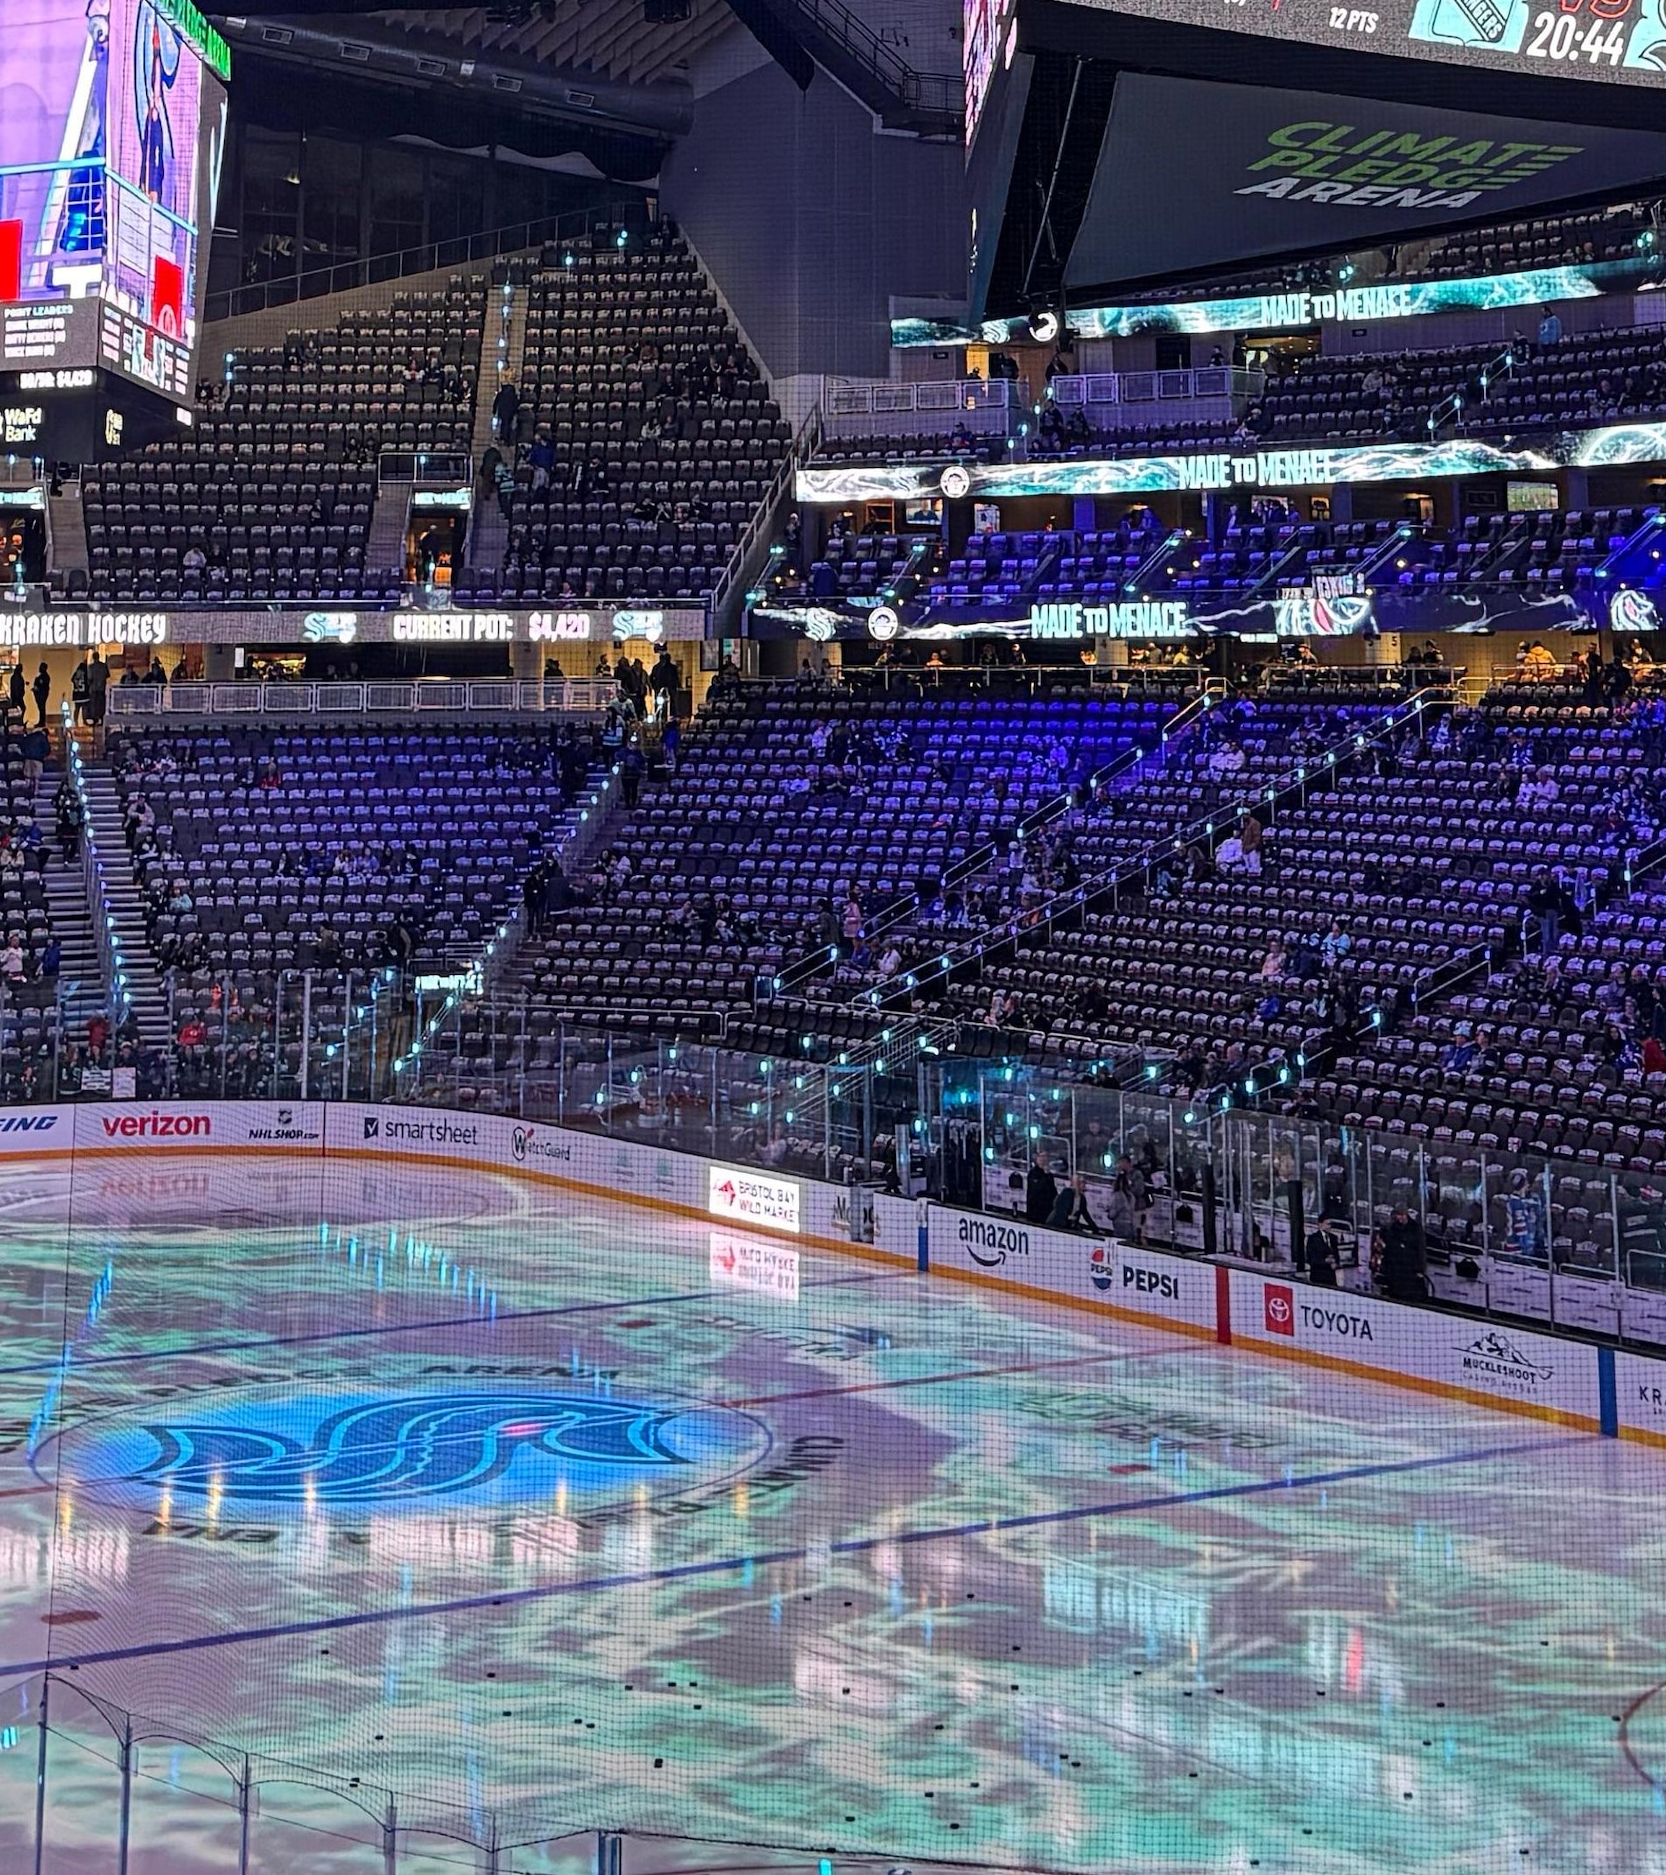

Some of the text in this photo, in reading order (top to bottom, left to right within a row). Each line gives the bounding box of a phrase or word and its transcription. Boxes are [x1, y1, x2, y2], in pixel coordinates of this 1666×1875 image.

[1329, 7, 1379, 33] 12 PTS
[1526, 12, 1626, 67] 20:44
[1267, 121, 1586, 169] CLIMATE
[1246, 149, 1541, 191] PLEDGE
[1233, 177, 1483, 209] ARENA
[1260, 284, 1414, 326] MADE TO MENACE
[4, 407, 42, 426] WaFd
[5, 425, 37, 443] Bank
[1179, 449, 1335, 490] MADE TO MENACE
[87, 611, 166, 645] HOCKEY
[393, 610, 591, 643] CURRENT POT: $4,420
[1031, 601, 1189, 639] MADE TO MENACE
[102, 1112, 211, 1138] verizon
[384, 1117, 478, 1147] smartsheet
[511, 1126, 571, 1162] WatchGuard
[738, 1180, 795, 1204] BRISTOL BAY
[738, 1198, 761, 1215] WILD
[958, 1217, 1030, 1257] amazon
[1089, 1262, 1113, 1277] PEPSI
[1122, 1263, 1179, 1301] PEPSI
[1300, 1303, 1373, 1342] TOYOTA
[1462, 1356, 1537, 1384] MUCKLESHOOT
